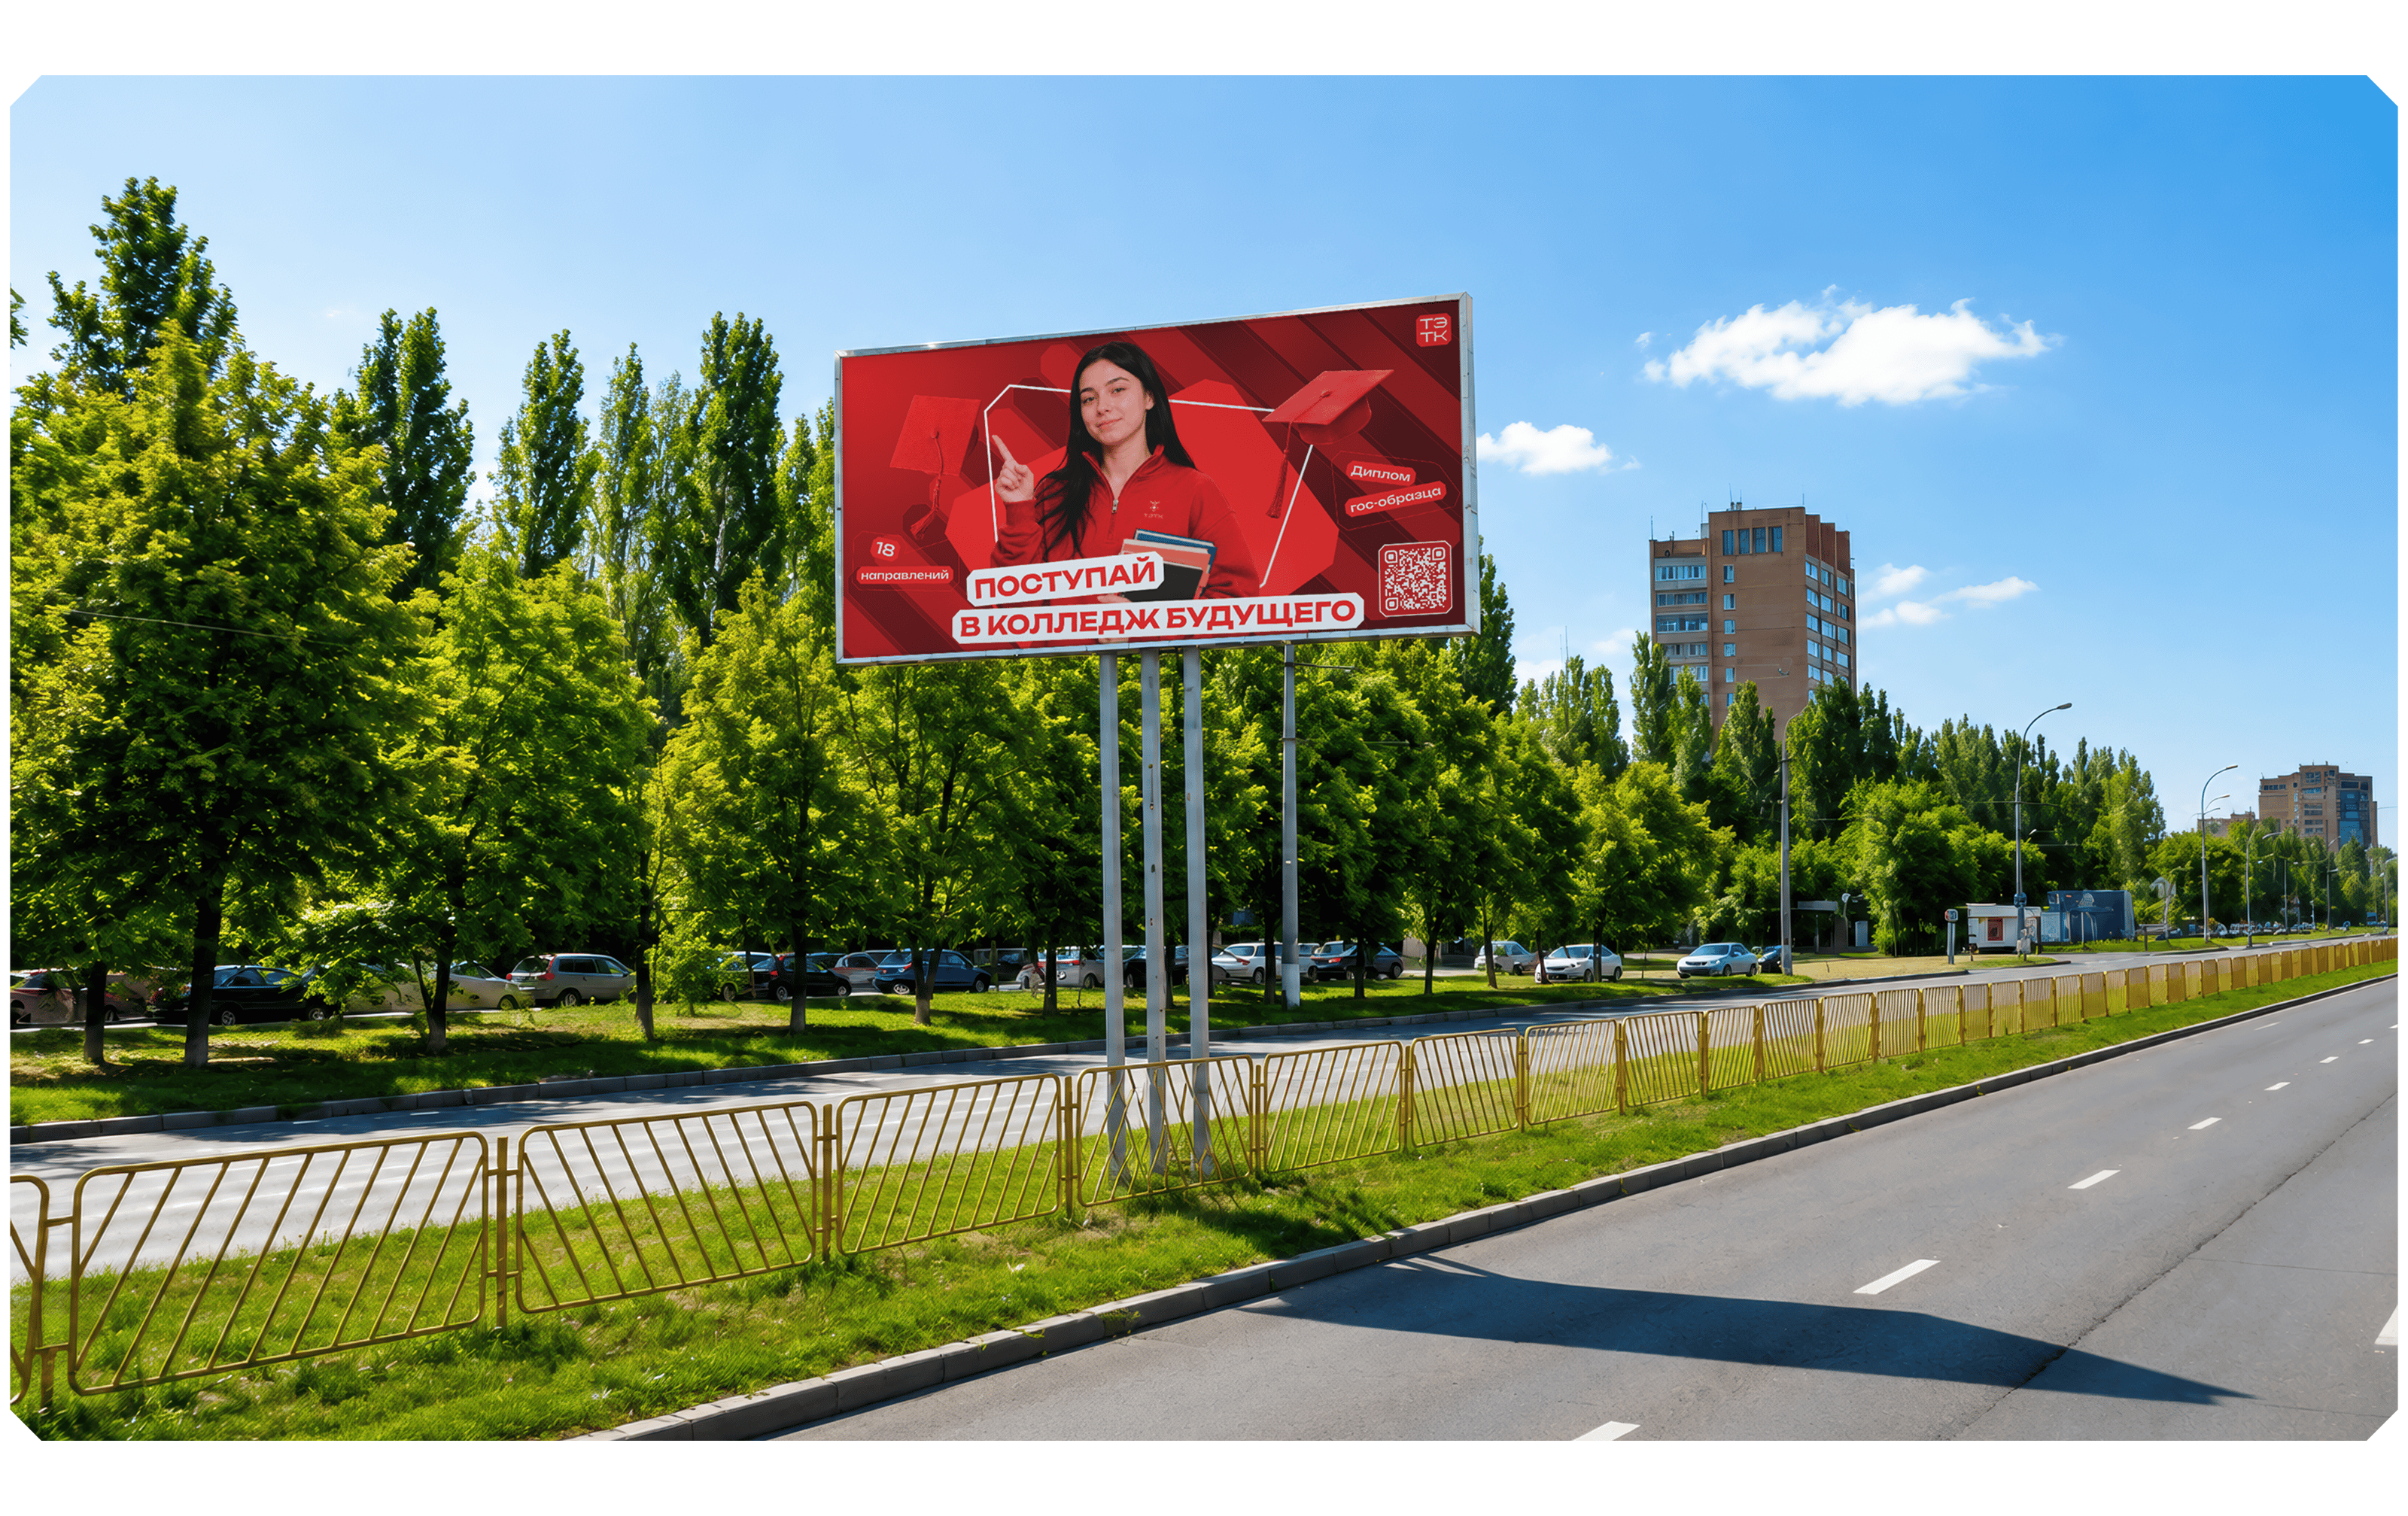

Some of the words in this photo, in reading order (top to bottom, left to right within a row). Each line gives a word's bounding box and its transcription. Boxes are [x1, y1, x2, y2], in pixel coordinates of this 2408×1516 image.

[1420, 317, 1448, 330] ТЭ
[1420, 330, 1448, 342] ТК
[1350, 465, 1411, 482] Диплом
[1350, 488, 1442, 513] гос-образца
[877, 542, 895, 557] 18
[861, 570, 950, 582] направлений
[975, 556, 1155, 600] ПОСТУПАЙ
[960, 616, 981, 637] В
[988, 608, 1160, 636] КОЛЛЕДЖ
[1166, 600, 1356, 630] БУДУЩЕГО
